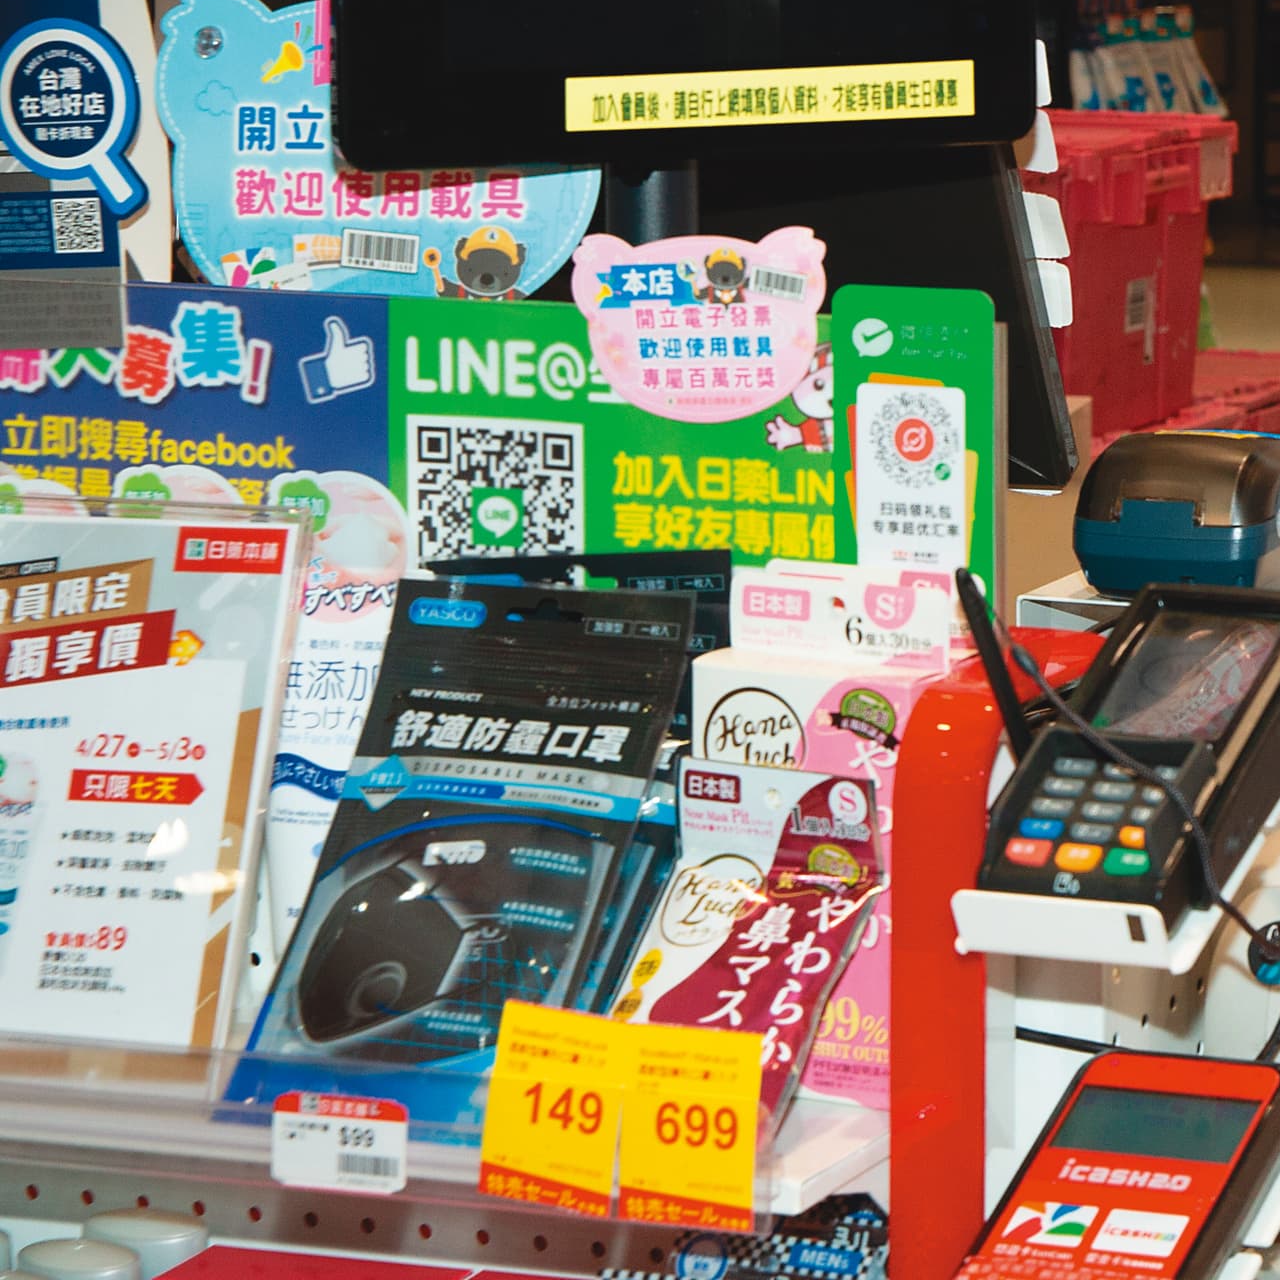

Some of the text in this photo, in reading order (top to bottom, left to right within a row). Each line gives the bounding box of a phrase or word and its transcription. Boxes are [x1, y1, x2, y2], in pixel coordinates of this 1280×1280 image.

[37, 67, 83, 92] 台灣
[19, 92, 107, 118] 在地好店
[235, 168, 526, 219] 歡迎使用載具
[621, 269, 675, 297] 本店
[634, 306, 773, 329] 開立電子發票
[638, 337, 774, 360] 歡迎使用載具
[641, 367, 777, 390] 專屬百萬元獎
[0, 572, 132, 624] 員限定
[750, 592, 803, 614] 日本製
[81, 774, 180, 802] 只限七天
[688, 775, 737, 801] 日本製
[524, 1082, 604, 1135] 149
[656, 1101, 739, 1151] 699
